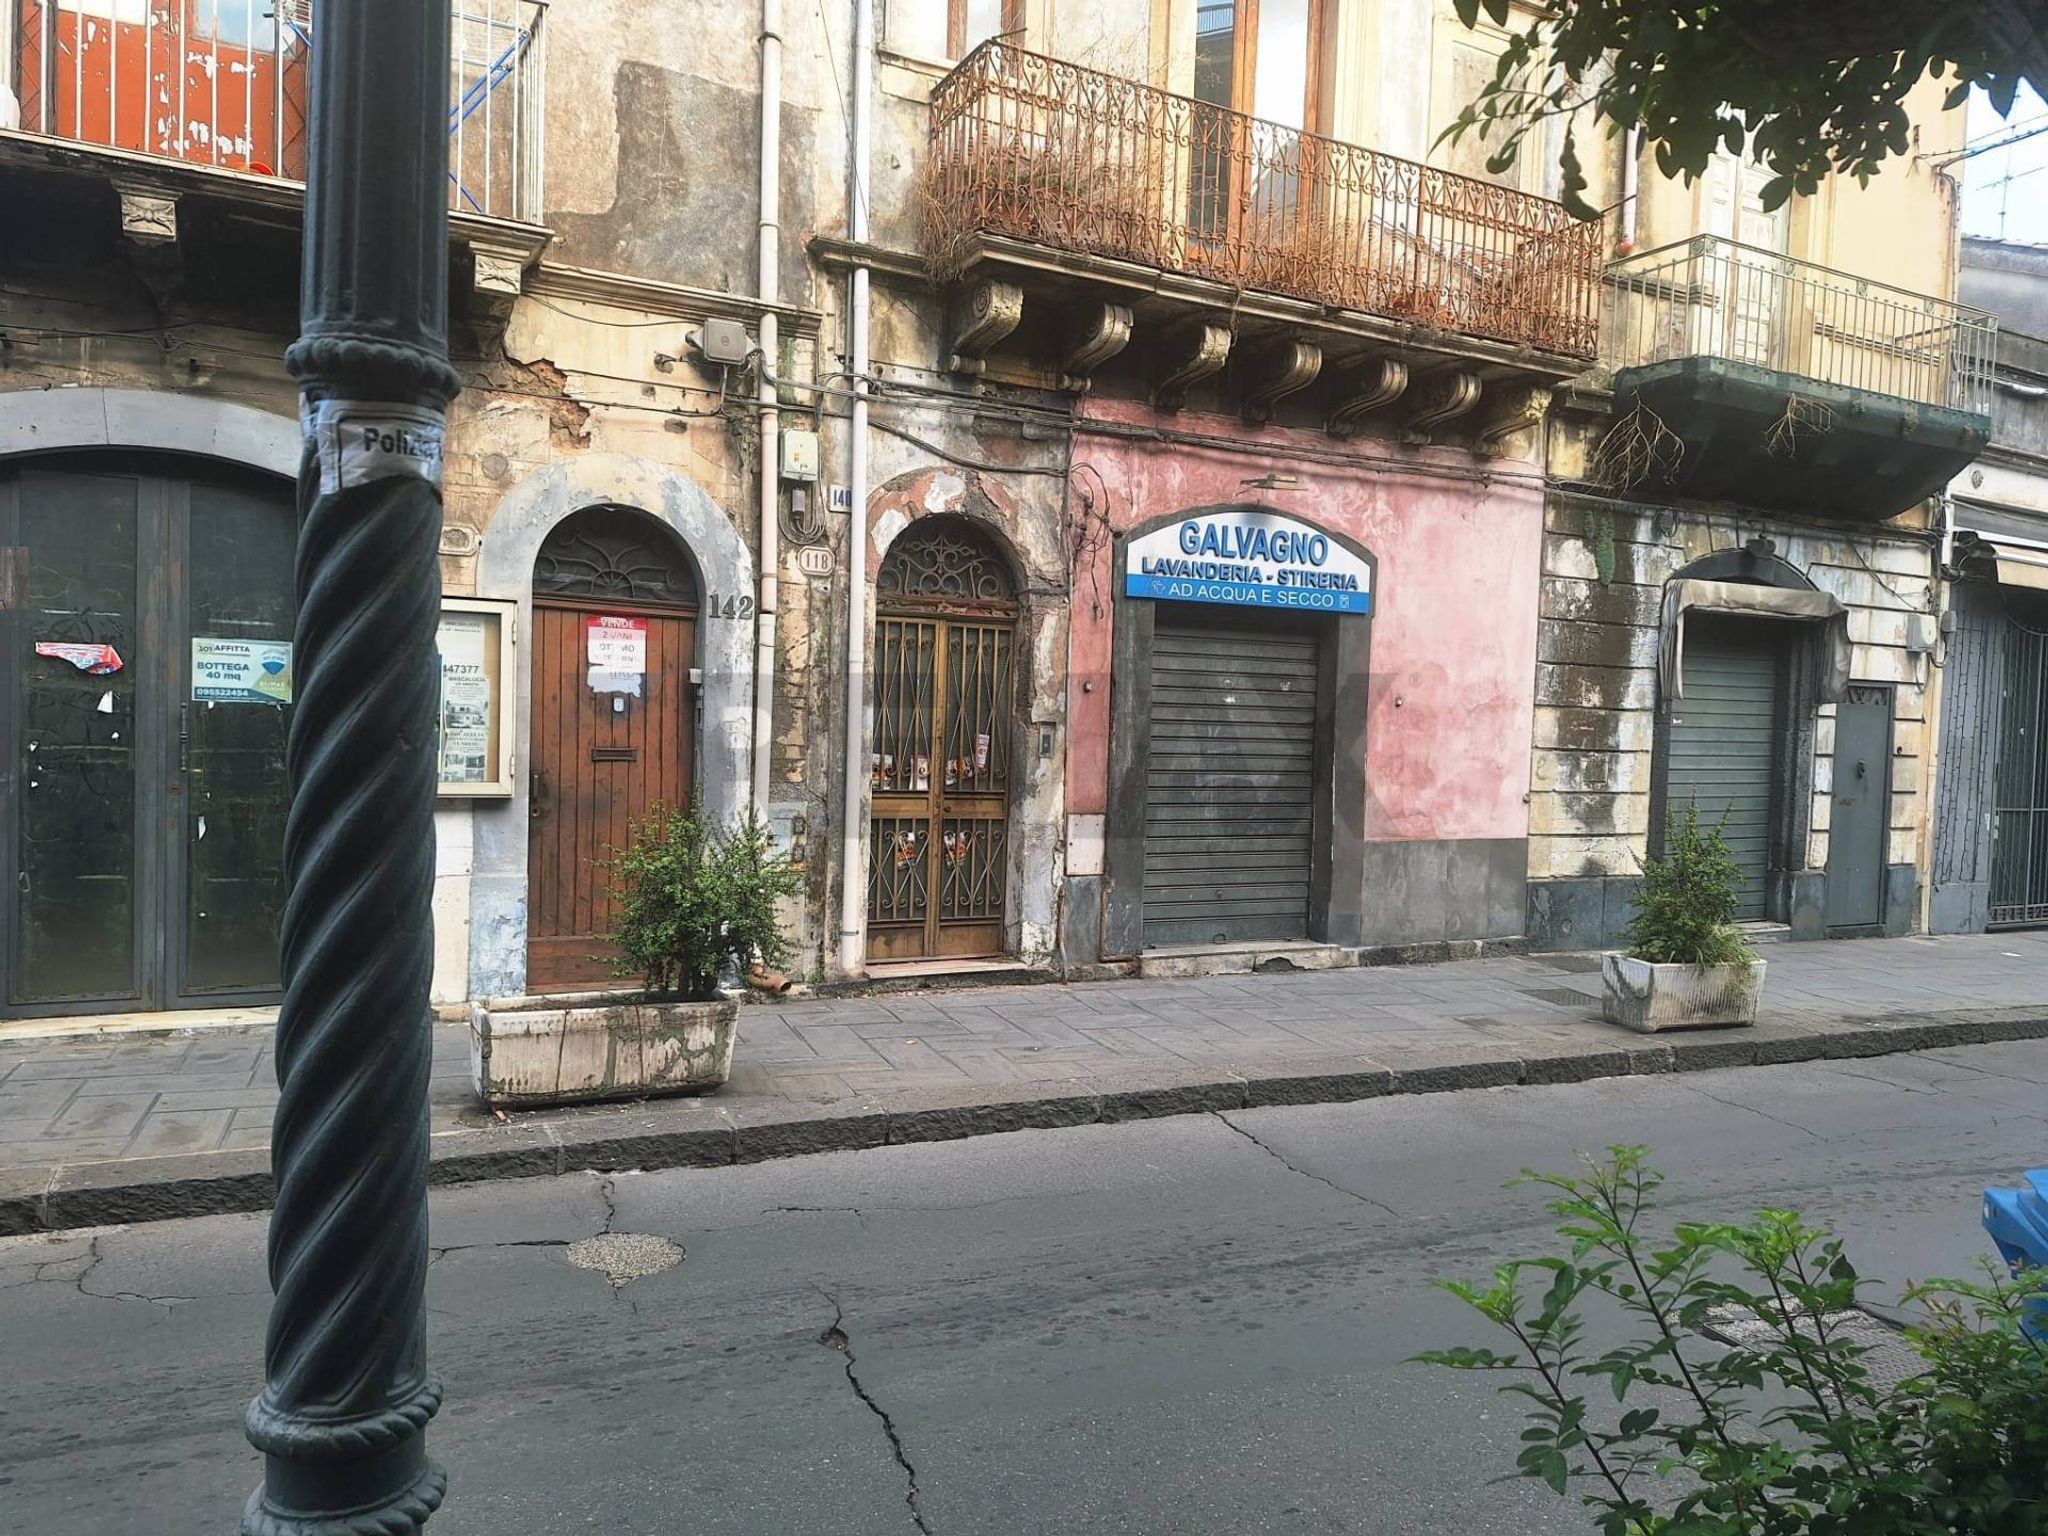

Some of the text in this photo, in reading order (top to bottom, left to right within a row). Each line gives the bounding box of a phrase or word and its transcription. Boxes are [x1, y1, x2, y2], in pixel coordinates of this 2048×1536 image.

[833, 489, 853, 507] 140
[1179, 521, 1329, 567] GALVAGNO
[806, 551, 828, 570] 118
[1142, 557, 1263, 583] LAVANDERIA
[1277, 569, 1359, 590] STIRERIA
[1168, 582, 1334, 608] AD ACQUA E SECCO
[709, 593, 754, 620] 142
[214, 644, 250, 653] AFFITTA
[197, 661, 250, 671] BOTTEGA
[206, 671, 242, 681] 40 mq
